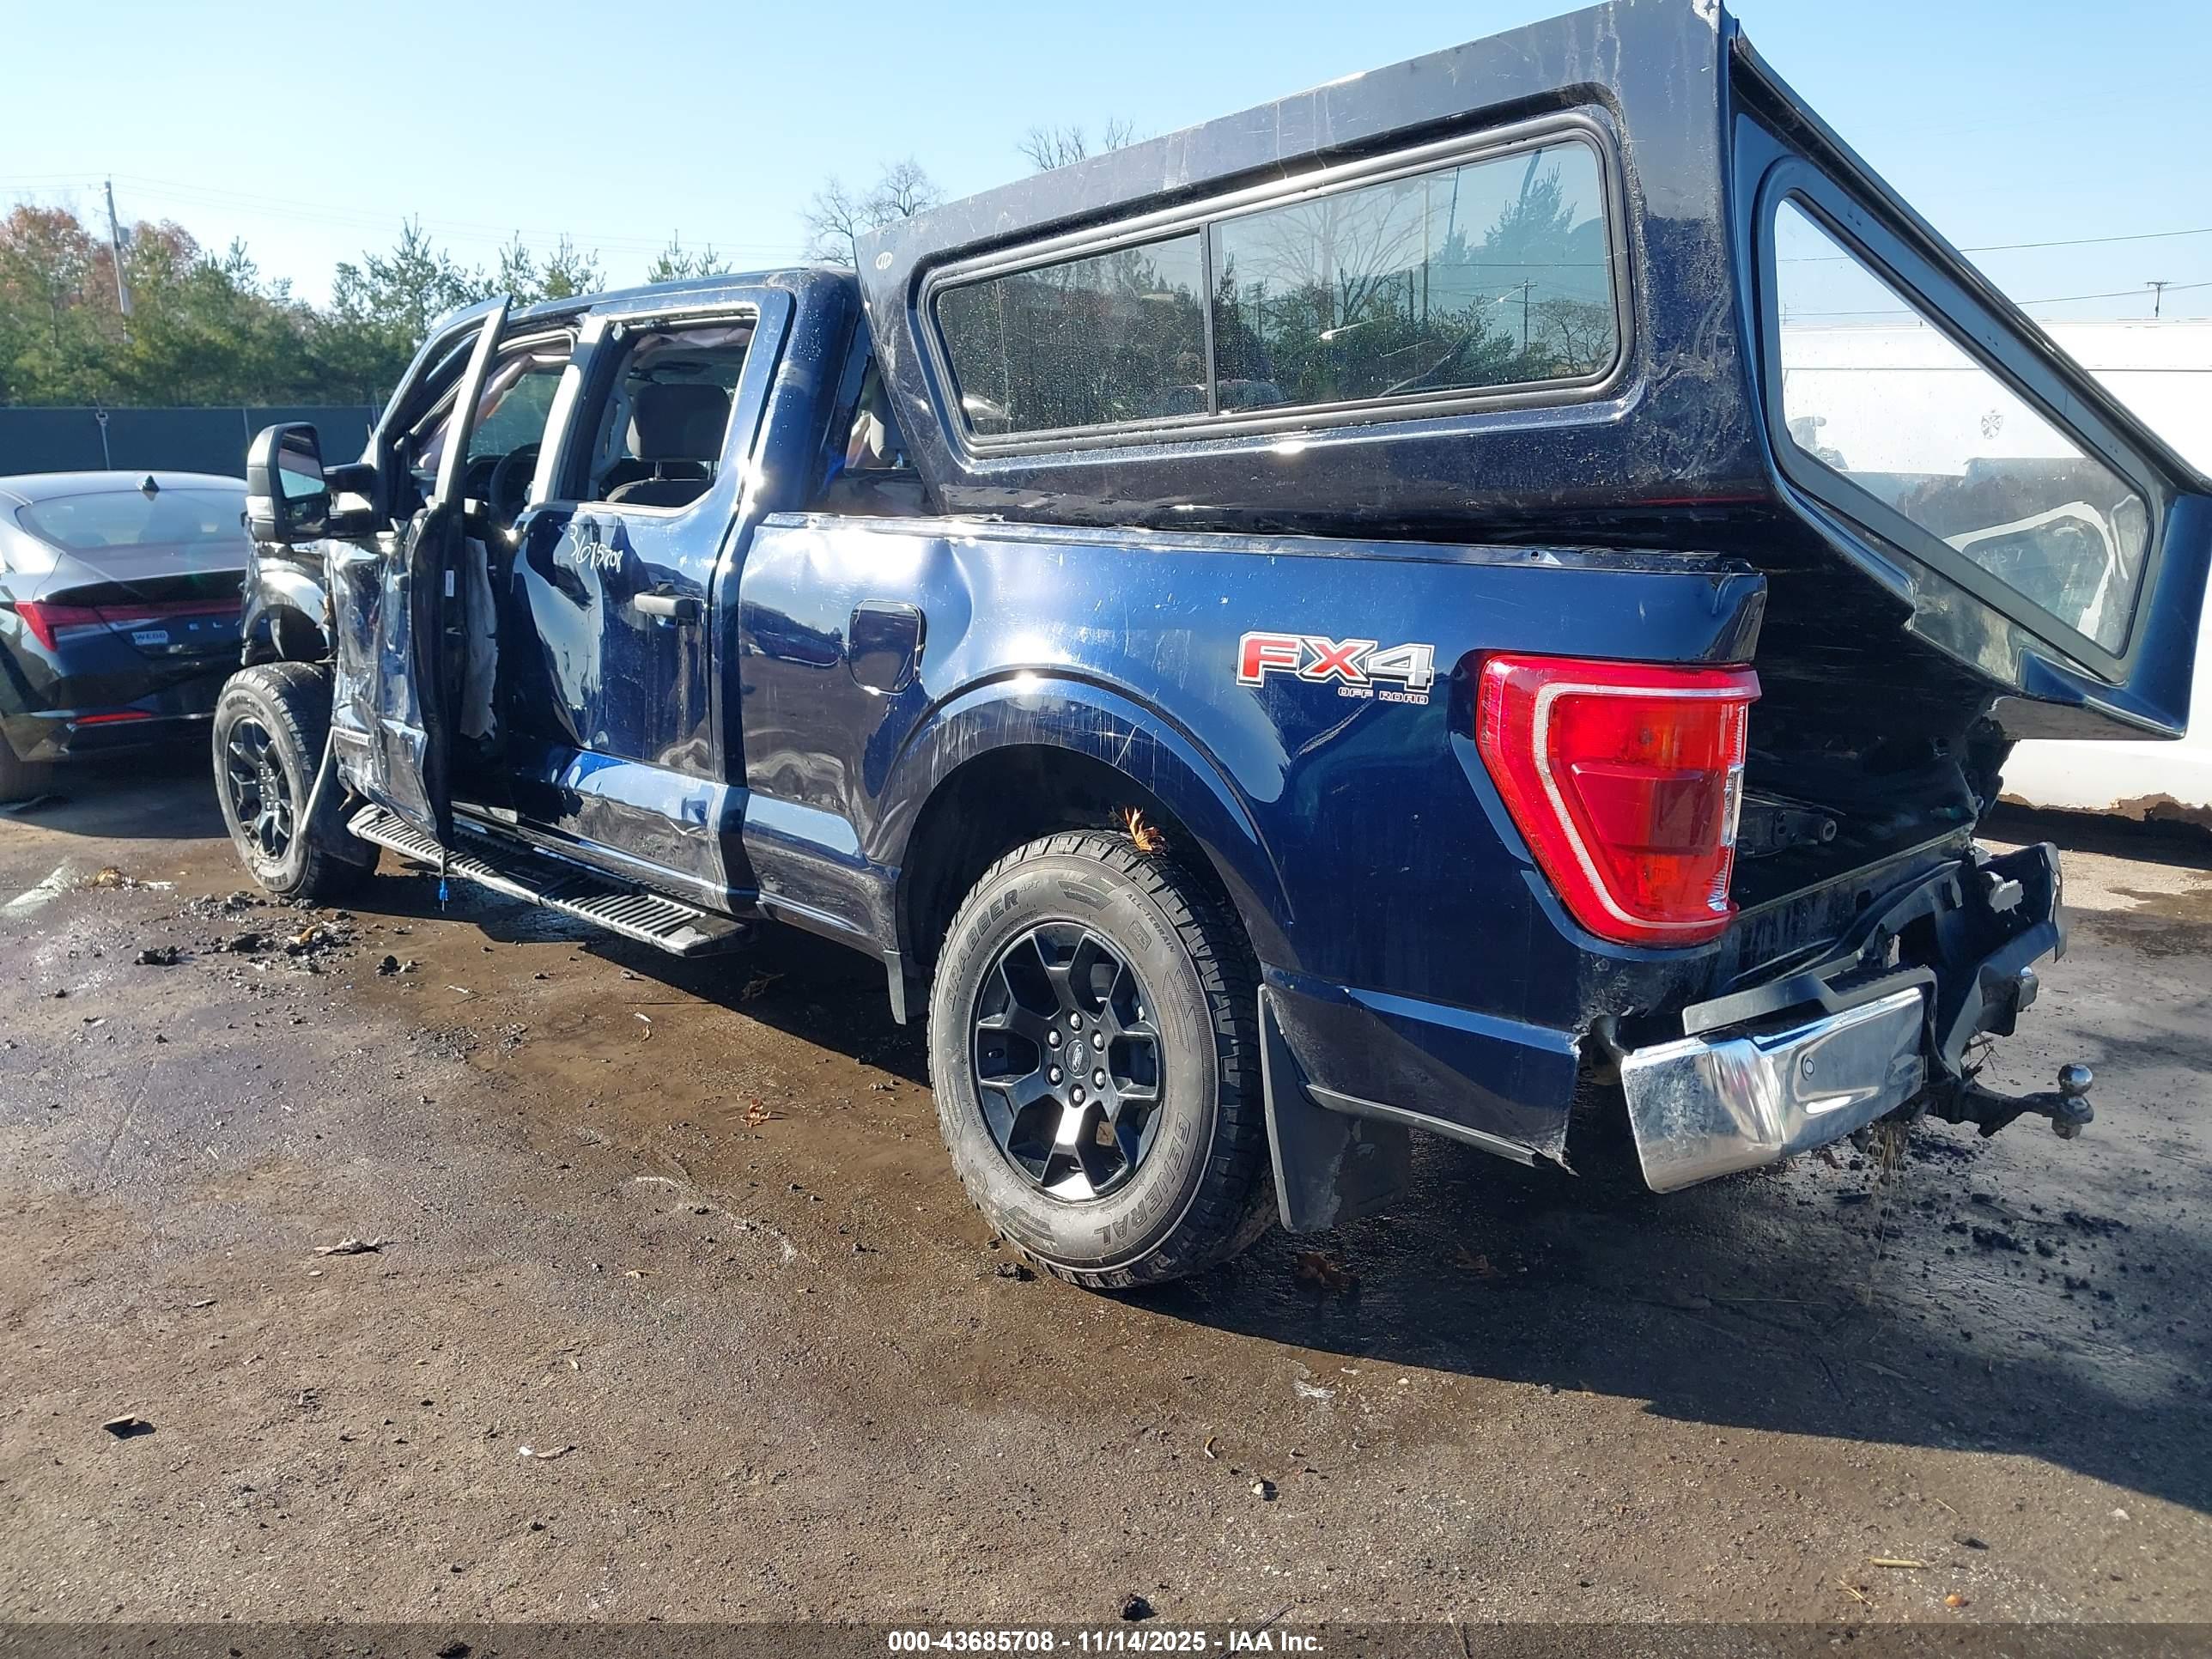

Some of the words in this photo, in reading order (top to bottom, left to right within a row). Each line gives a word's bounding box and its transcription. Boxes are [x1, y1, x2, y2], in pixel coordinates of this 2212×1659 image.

[1237, 631, 1436, 694] FX4
[1338, 686, 1374, 699] OFF
[1379, 690, 1429, 705] ROAD
[944, 888, 1018, 1013] GRABBER
[1126, 893, 1176, 954] ALL-TERRAIN
[1093, 1111, 1192, 1246] GENERAL
